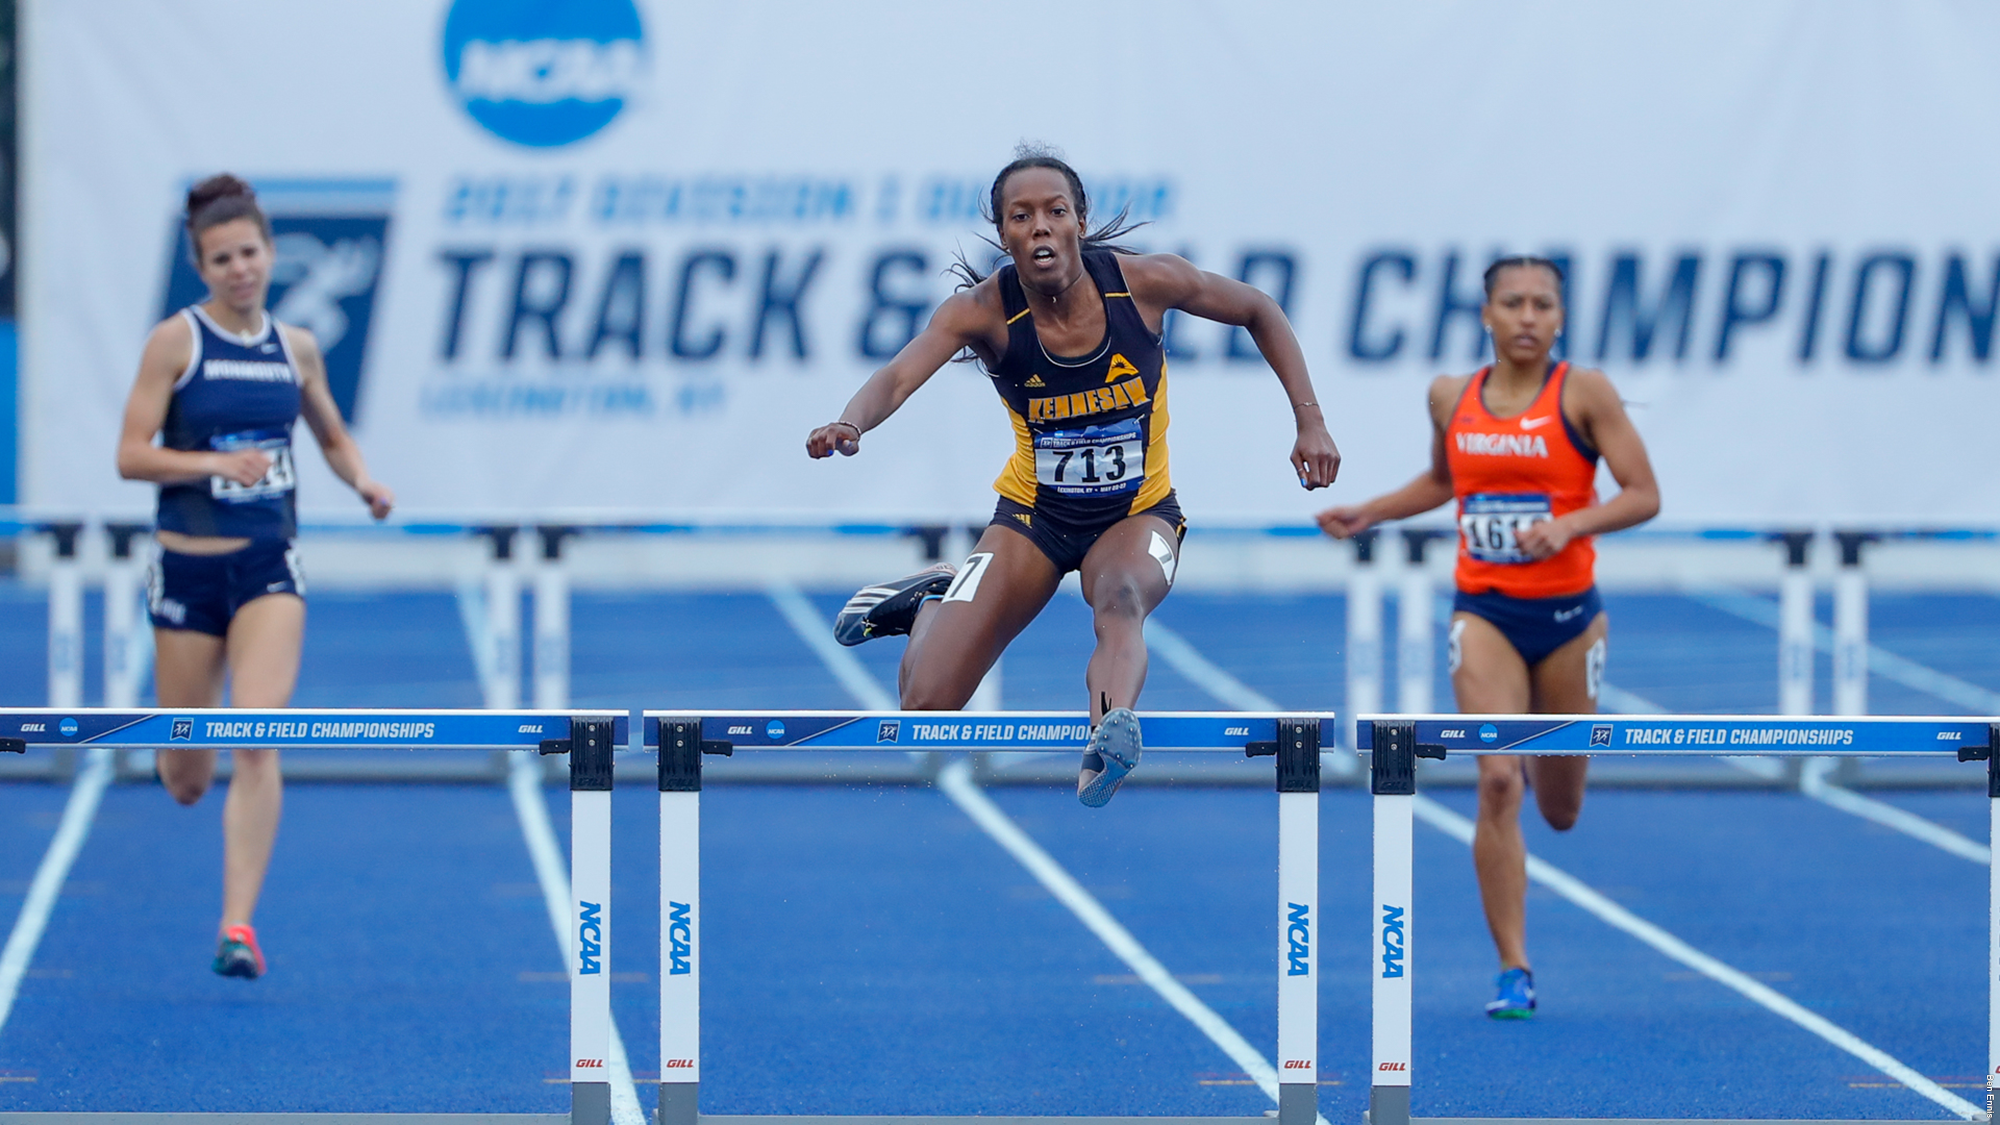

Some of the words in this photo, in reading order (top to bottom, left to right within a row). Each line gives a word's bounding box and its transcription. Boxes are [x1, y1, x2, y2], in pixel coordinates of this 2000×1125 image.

[433, 249, 830, 362] TRACK
[1028, 377, 1150, 424] KENNESAW
[1456, 432, 1548, 458] VIRGINIA
[1053, 445, 1126, 482] 713
[1467, 514, 1546, 550] 161
[20, 723, 46, 732] GILL
[205, 722, 252, 738] TRACK
[254, 722, 266, 738] &
[267, 722, 308, 738] FIELD
[311, 722, 435, 738] CHAMPIONSHIPS
[518, 724, 543, 733] GILL
[727, 726, 753, 735] GILL
[912, 724, 958, 740] TRACK
[961, 724, 973, 740] &
[975, 724, 1014, 740] FIELD
[1224, 727, 1249, 736] GILL
[1440, 729, 1465, 738] GILL
[1936, 731, 1962, 740] GILL
[1625, 728, 1671, 745] TRACK
[1673, 728, 1685, 745] &
[1687, 728, 1727, 745] FIELD
[1729, 728, 1854, 745] CHAMPIONSHIPS
[580, 901, 601, 975] NCAA
[670, 901, 691, 975] NCAA
[1288, 902, 1309, 976] NCAA
[1383, 904, 1404, 978] NCAA
[576, 1059, 603, 1068] GILL
[666, 1059, 694, 1068] GILL
[1284, 1060, 1312, 1069] GILL
[1379, 1062, 1406, 1071] GILL
